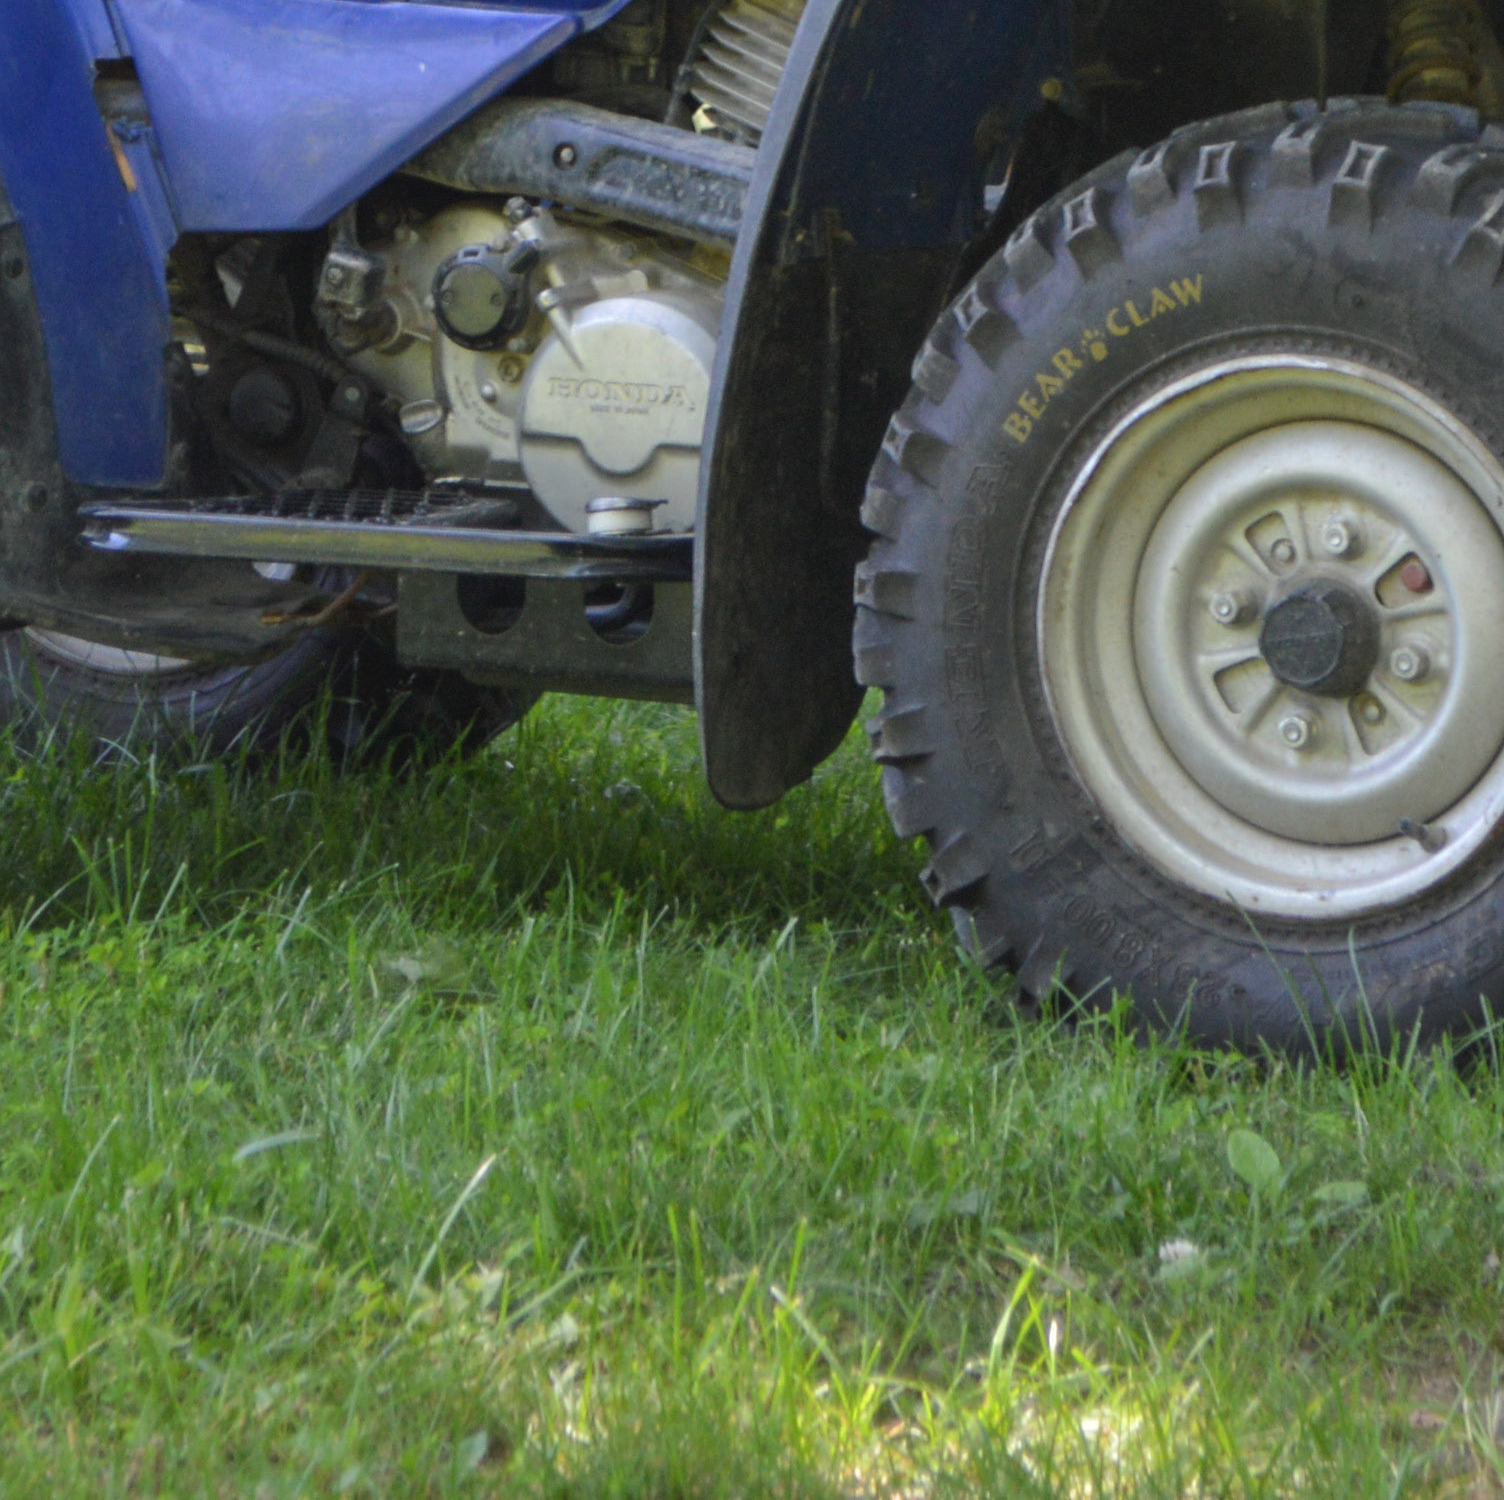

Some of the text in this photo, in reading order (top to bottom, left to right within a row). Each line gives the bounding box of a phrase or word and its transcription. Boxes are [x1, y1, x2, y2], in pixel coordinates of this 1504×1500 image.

[548, 376, 694, 406] HONDA
[1002, 273, 1203, 444] BEAR CLAW
